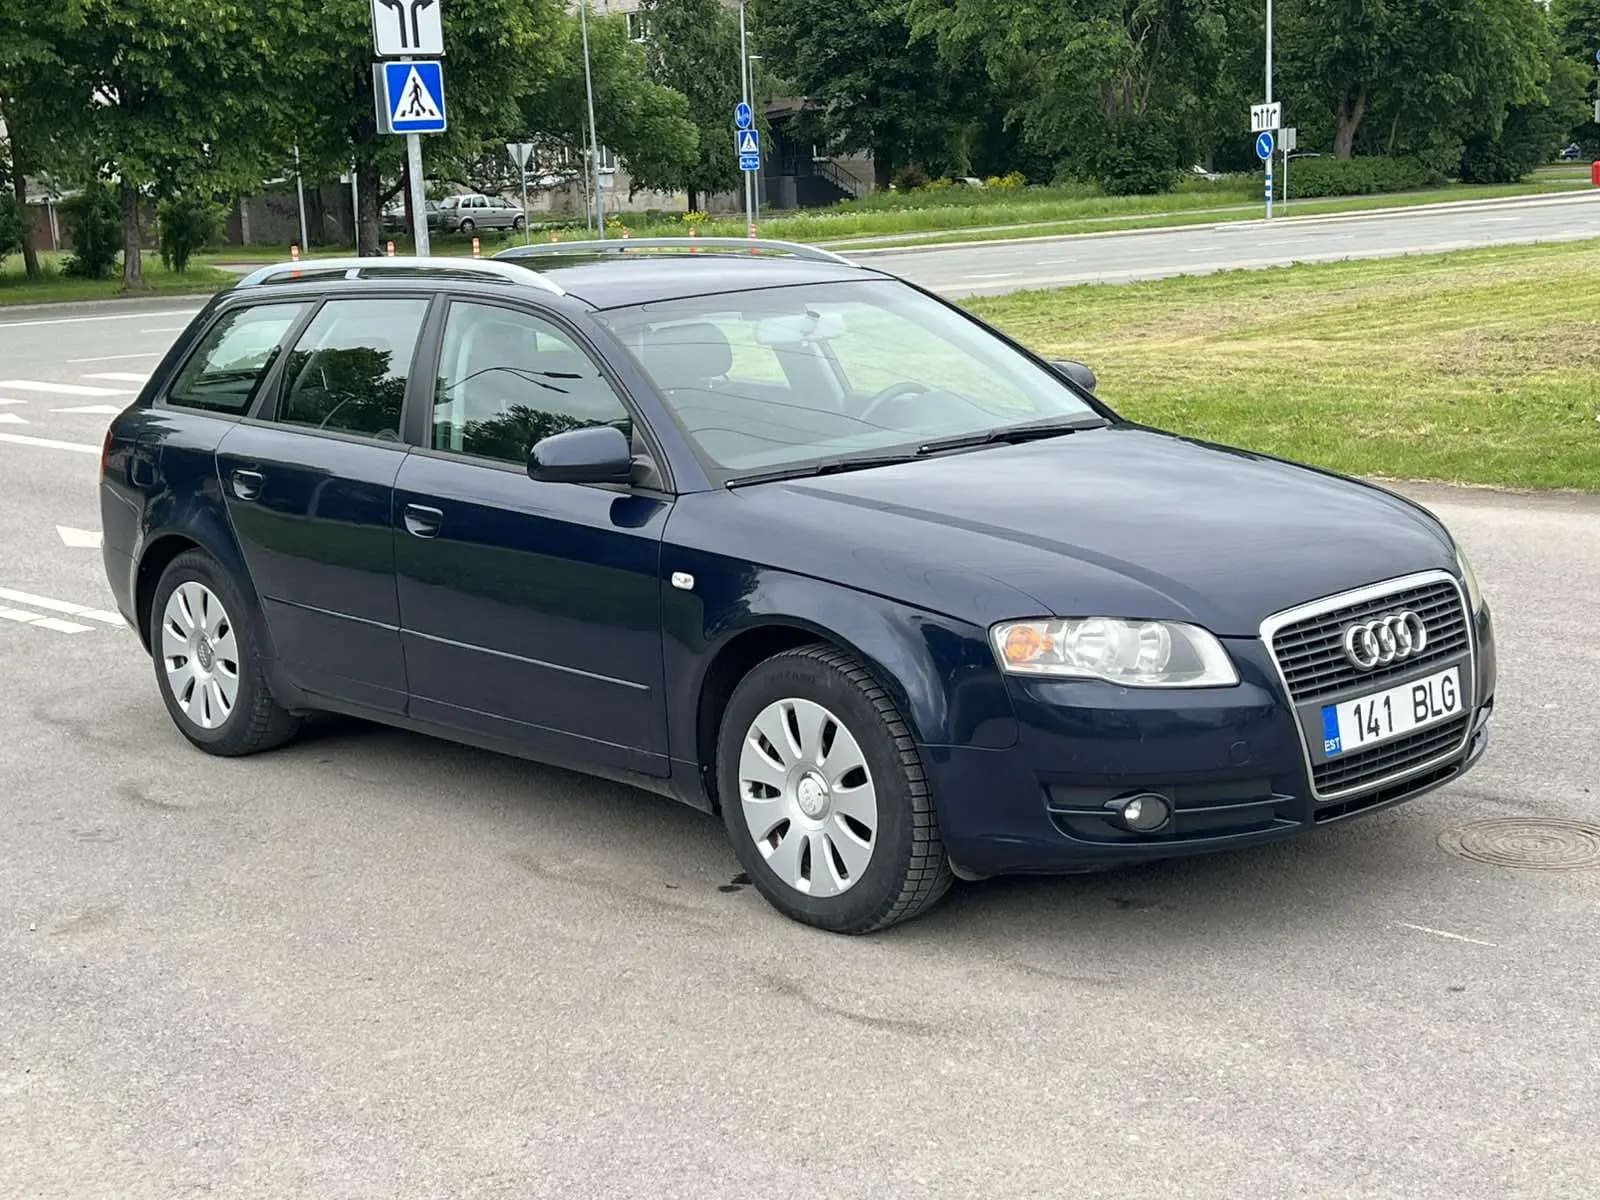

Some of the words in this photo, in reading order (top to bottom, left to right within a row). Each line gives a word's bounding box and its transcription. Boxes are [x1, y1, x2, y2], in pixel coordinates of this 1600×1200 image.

[1354, 695, 1392, 742] 141
[1412, 675, 1456, 723] BLG
[1324, 737, 1341, 752] EST
